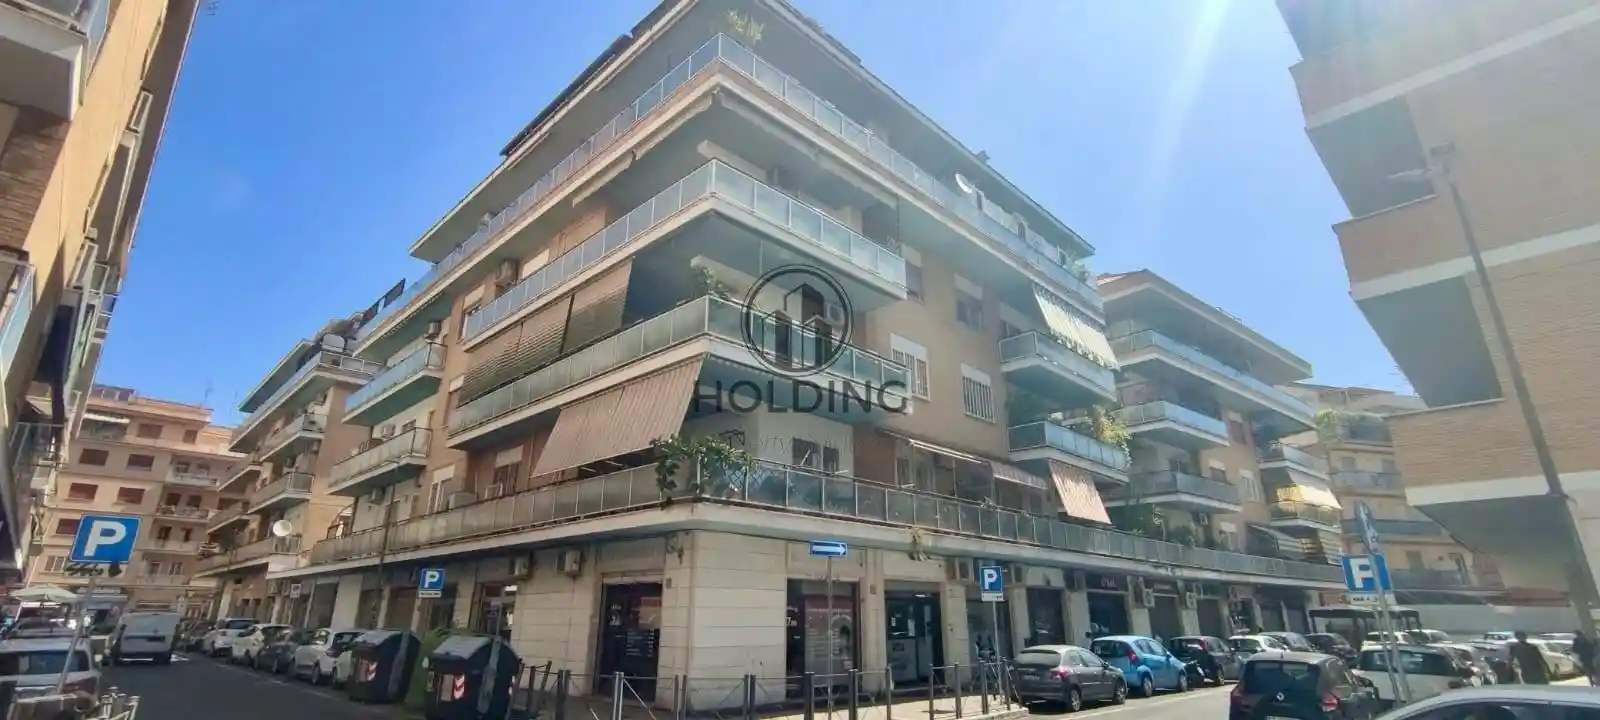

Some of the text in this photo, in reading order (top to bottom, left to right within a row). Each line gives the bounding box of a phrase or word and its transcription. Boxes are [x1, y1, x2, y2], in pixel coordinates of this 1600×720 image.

[84, 521, 126, 556] P
[424, 570, 440, 588] P
[983, 568, 998, 590] P
